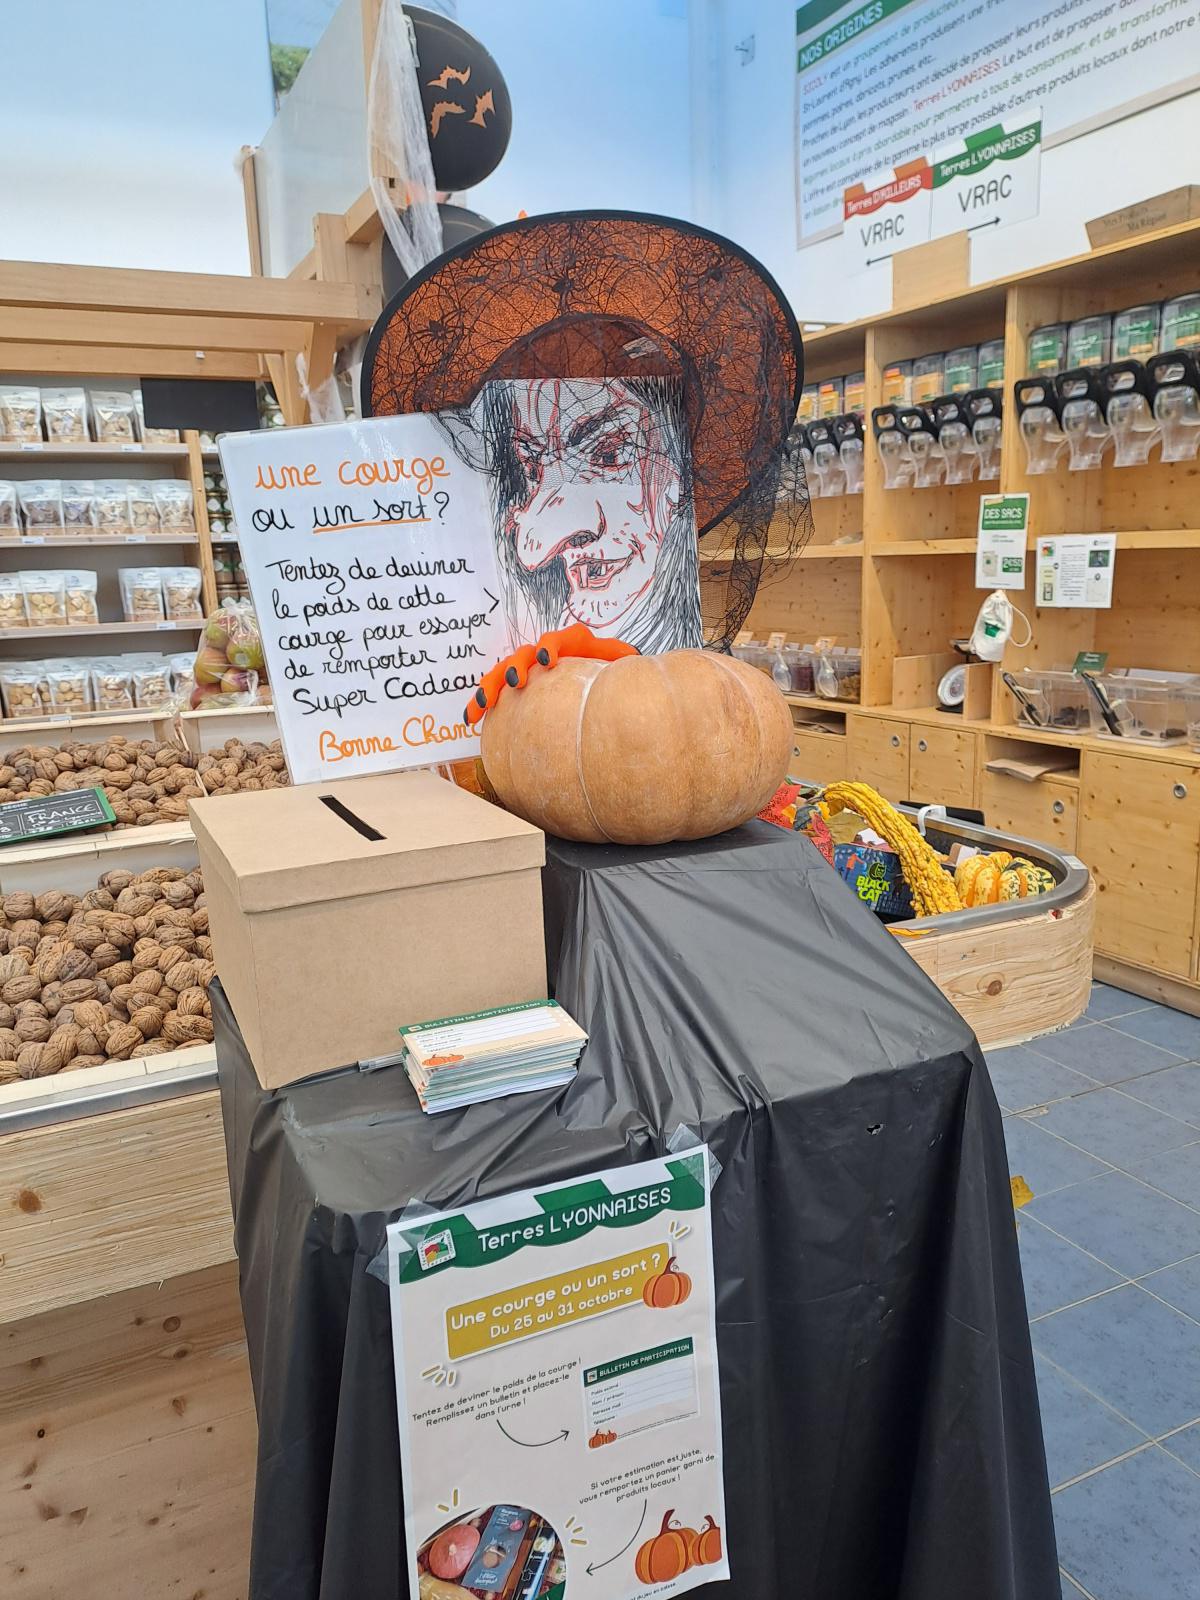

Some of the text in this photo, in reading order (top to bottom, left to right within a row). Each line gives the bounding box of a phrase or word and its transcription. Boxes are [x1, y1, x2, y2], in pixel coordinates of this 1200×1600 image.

[800, 1, 884, 68] NOS ORIGINES
[960, 55, 971, 68] de
[972, 32, 1014, 63] proposer
[1016, 18, 1041, 39] leurs
[1016, 44, 1033, 61] but
[1034, 35, 1050, 51] est
[1052, 28, 1065, 43] de
[1066, 3, 1116, 38] proposer
[933, 94, 980, 123] permettre
[1011, 71, 1024, 85] de
[1088, 33, 1101, 48] et
[1103, 24, 1118, 41] de
[971, 101, 1006, 126] possible
[1008, 82, 1048, 109] d'autres
[1048, 61, 1091, 93] produits
[1093, 46, 1128, 69] locaux
[1131, 31, 1158, 52] dont
[1159, 16, 1196, 39] notre
[940, 128, 1036, 177] Terres LYONNAISES
[847, 197, 873, 213] Terres
[957, 174, 1012, 213] VRAC
[860, 214, 905, 247] VRAC
[338, 456, 451, 495] courge
[252, 507, 295, 532] ou
[312, 504, 365, 529] un
[984, 507, 1023, 520] DES SACS
[264, 552, 475, 595] Tentez de deviner
[272, 584, 456, 627] le poids de cette
[278, 612, 491, 660] courge pour essayer
[284, 642, 486, 680] de remporter un
[293, 687, 377, 719] Super
[319, 730, 402, 762] Bonne
[28, 803, 96, 823] FRANCE
[856, 875, 891, 892] BLACK
[858, 888, 883, 902] CAT
[478, 1223, 544, 1252] Terres
[549, 1187, 671, 1234] LYONNAISES
[450, 1252, 662, 1330] Une courge ou un sort ?
[490, 1284, 633, 1338] Du 25 au 31 octobre
[600, 1343, 690, 1377] BULLETIN DE PARTICIPATION
[412, 1407, 442, 1422] Tentez
[444, 1401, 455, 1411] de
[457, 1390, 490, 1406] deviner
[493, 1385, 501, 1394] le
[502, 1378, 525, 1394] poids
[527, 1373, 537, 1384] de
[538, 1369, 546, 1379] la
[547, 1360, 577, 1375] courge
[426, 1373, 570, 1428] Remplissez un bulletin et placez-le
[475, 1409, 495, 1421] dans
[497, 1401, 522, 1414] l'urne
[579, 1494, 598, 1504] vous
[599, 1478, 643, 1497] remportez
[656, 1465, 681, 1479] panier
[683, 1458, 704, 1470] garni
[705, 1454, 715, 1462] de
[590, 1482, 599, 1490] Si
[600, 1474, 622, 1487] votre
[624, 1459, 665, 1478] estimation
[666, 1456, 679, 1464] est
[616, 1485, 649, 1503] produits
[650, 1476, 677, 1490] locaux
